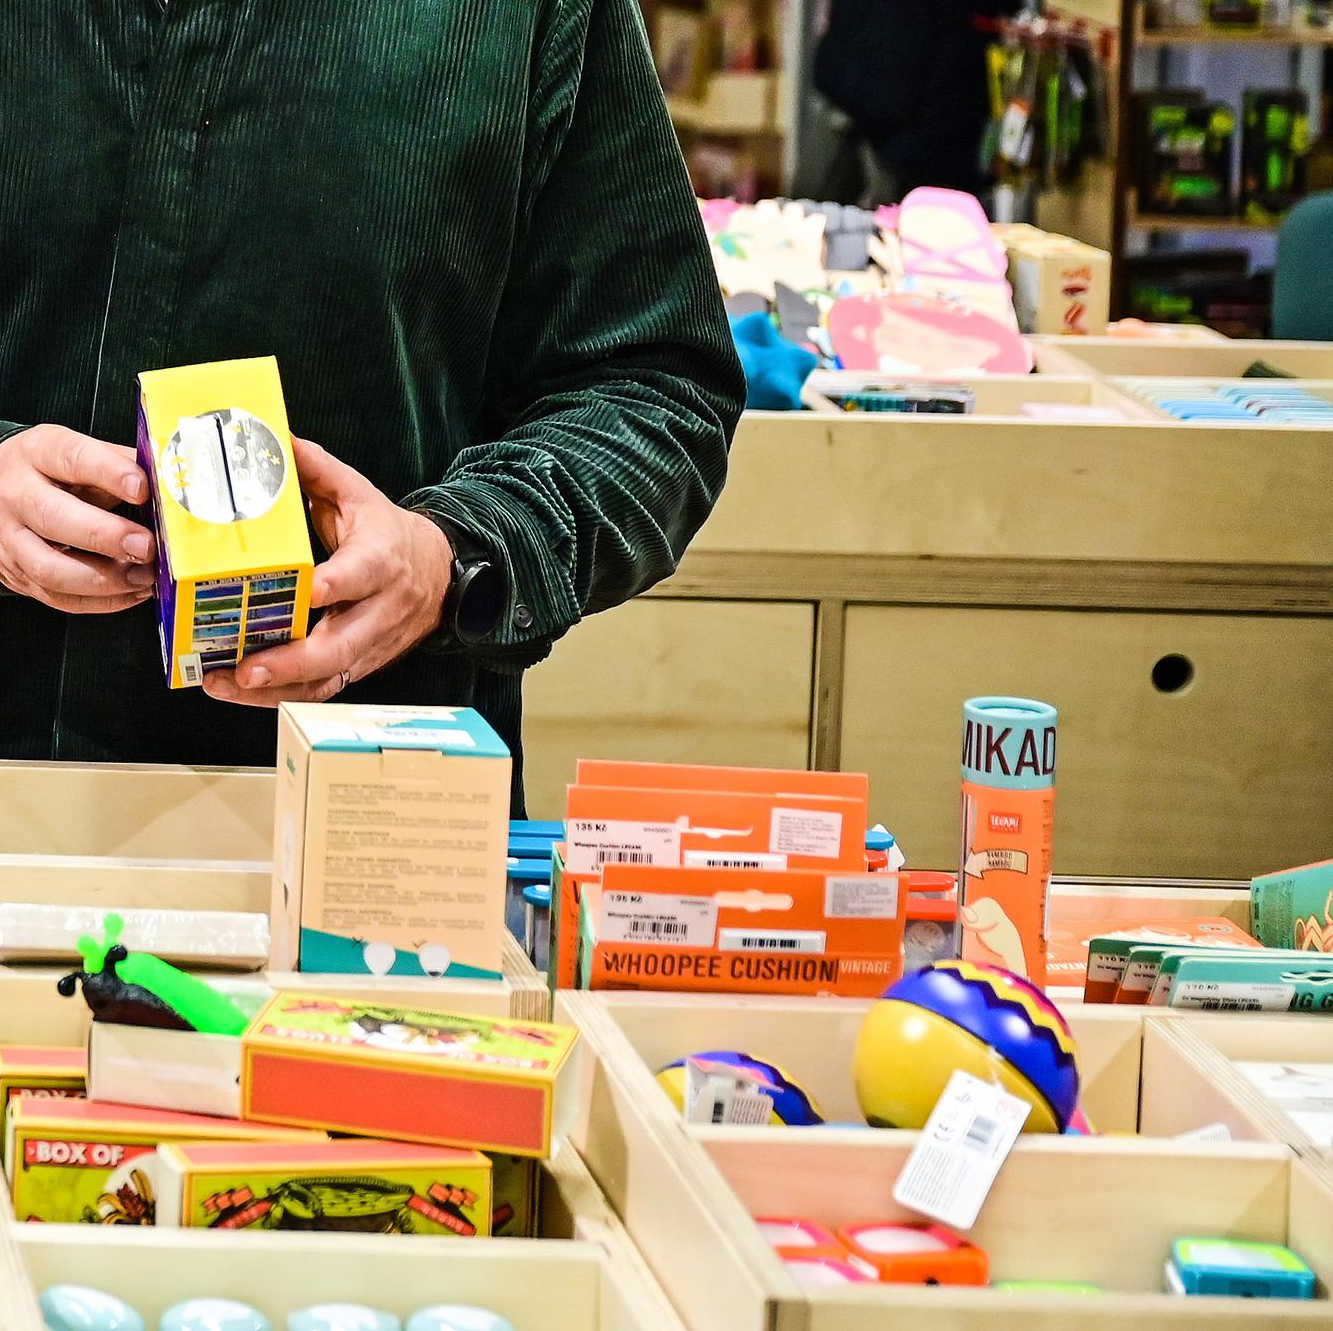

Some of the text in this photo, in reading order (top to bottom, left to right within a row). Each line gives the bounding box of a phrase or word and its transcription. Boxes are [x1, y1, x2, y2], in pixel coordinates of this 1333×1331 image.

[604, 952, 891, 982] WHOOPEE CUSHION VINTAGE
[35, 1141, 125, 1166] BOX OF
